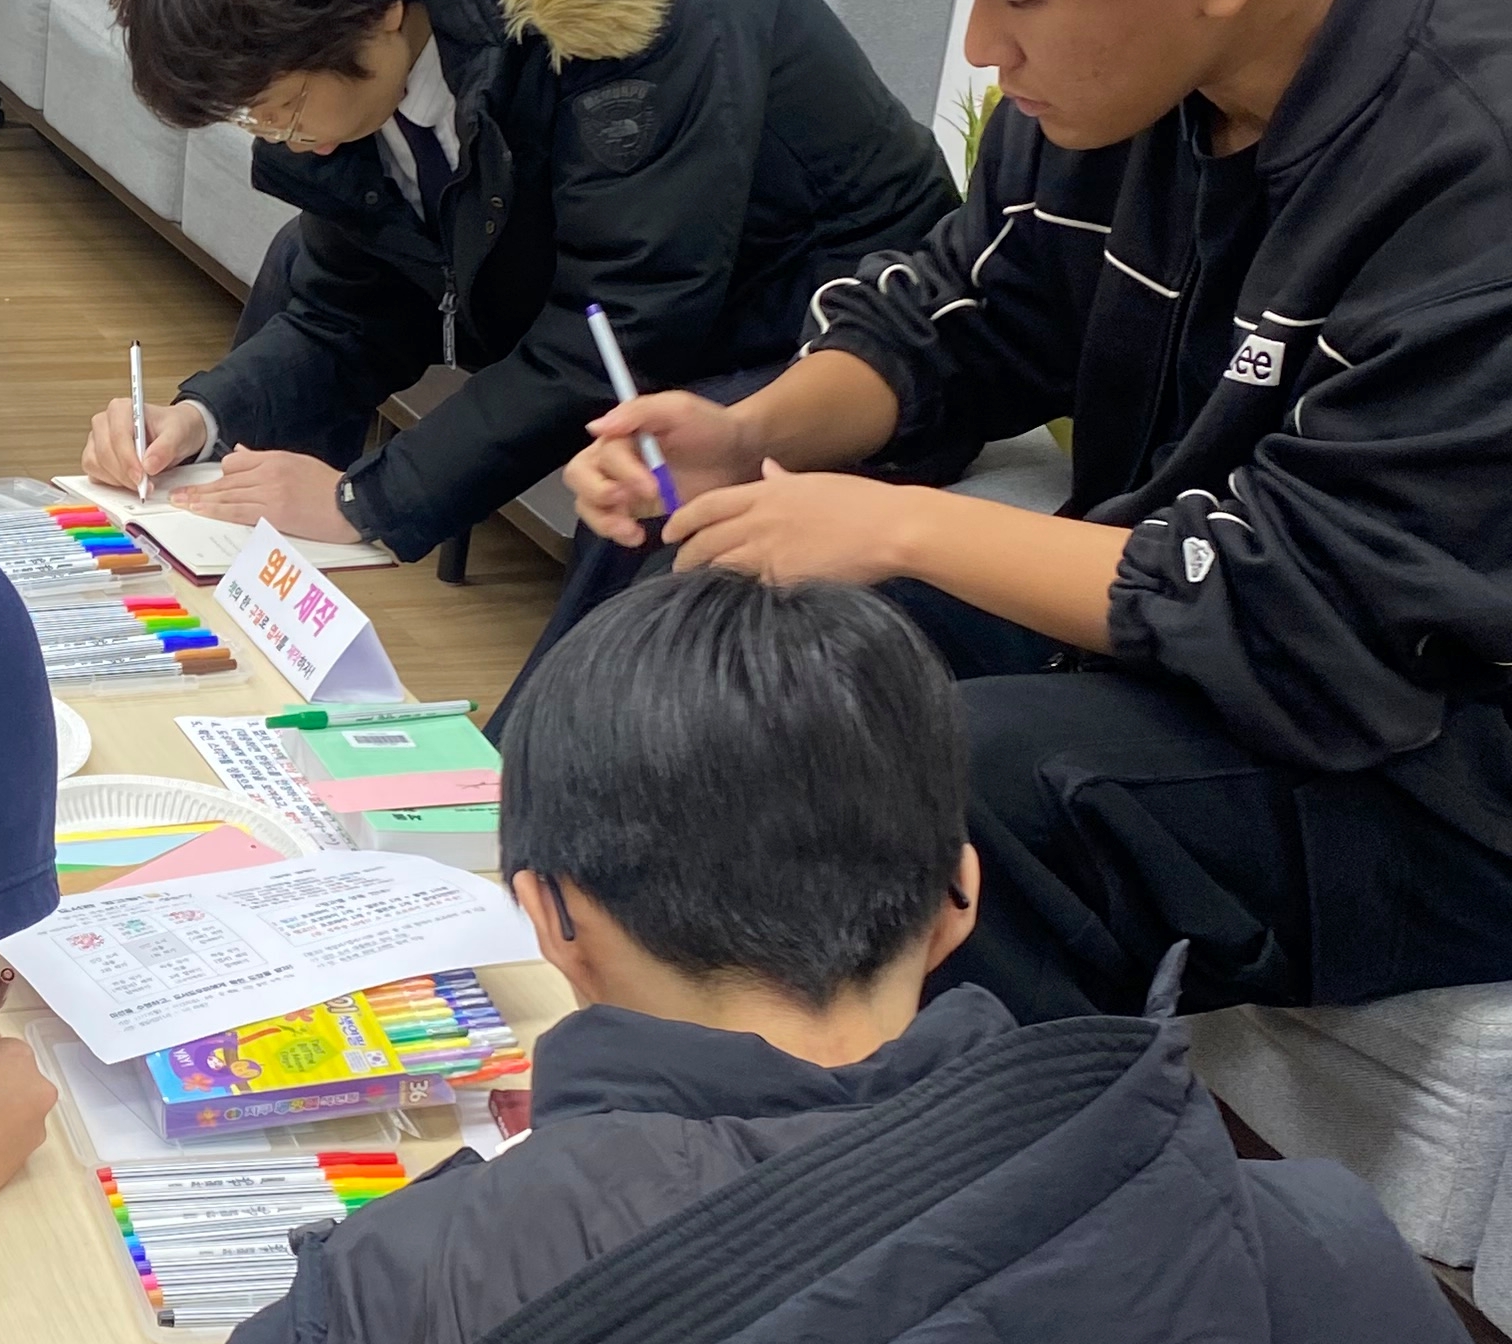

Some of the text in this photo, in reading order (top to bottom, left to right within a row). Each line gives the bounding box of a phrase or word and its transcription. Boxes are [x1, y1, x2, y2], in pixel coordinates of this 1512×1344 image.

[1235, 347, 1272, 380] ee
[257, 547, 339, 638] 엽서 제작
[239, 594, 252, 612] 한
[248, 603, 270, 630] 구절로
[266, 623, 290, 652] 엽서를
[338, 1015, 367, 1048] 색연필
[408, 1079, 430, 1104] 36
